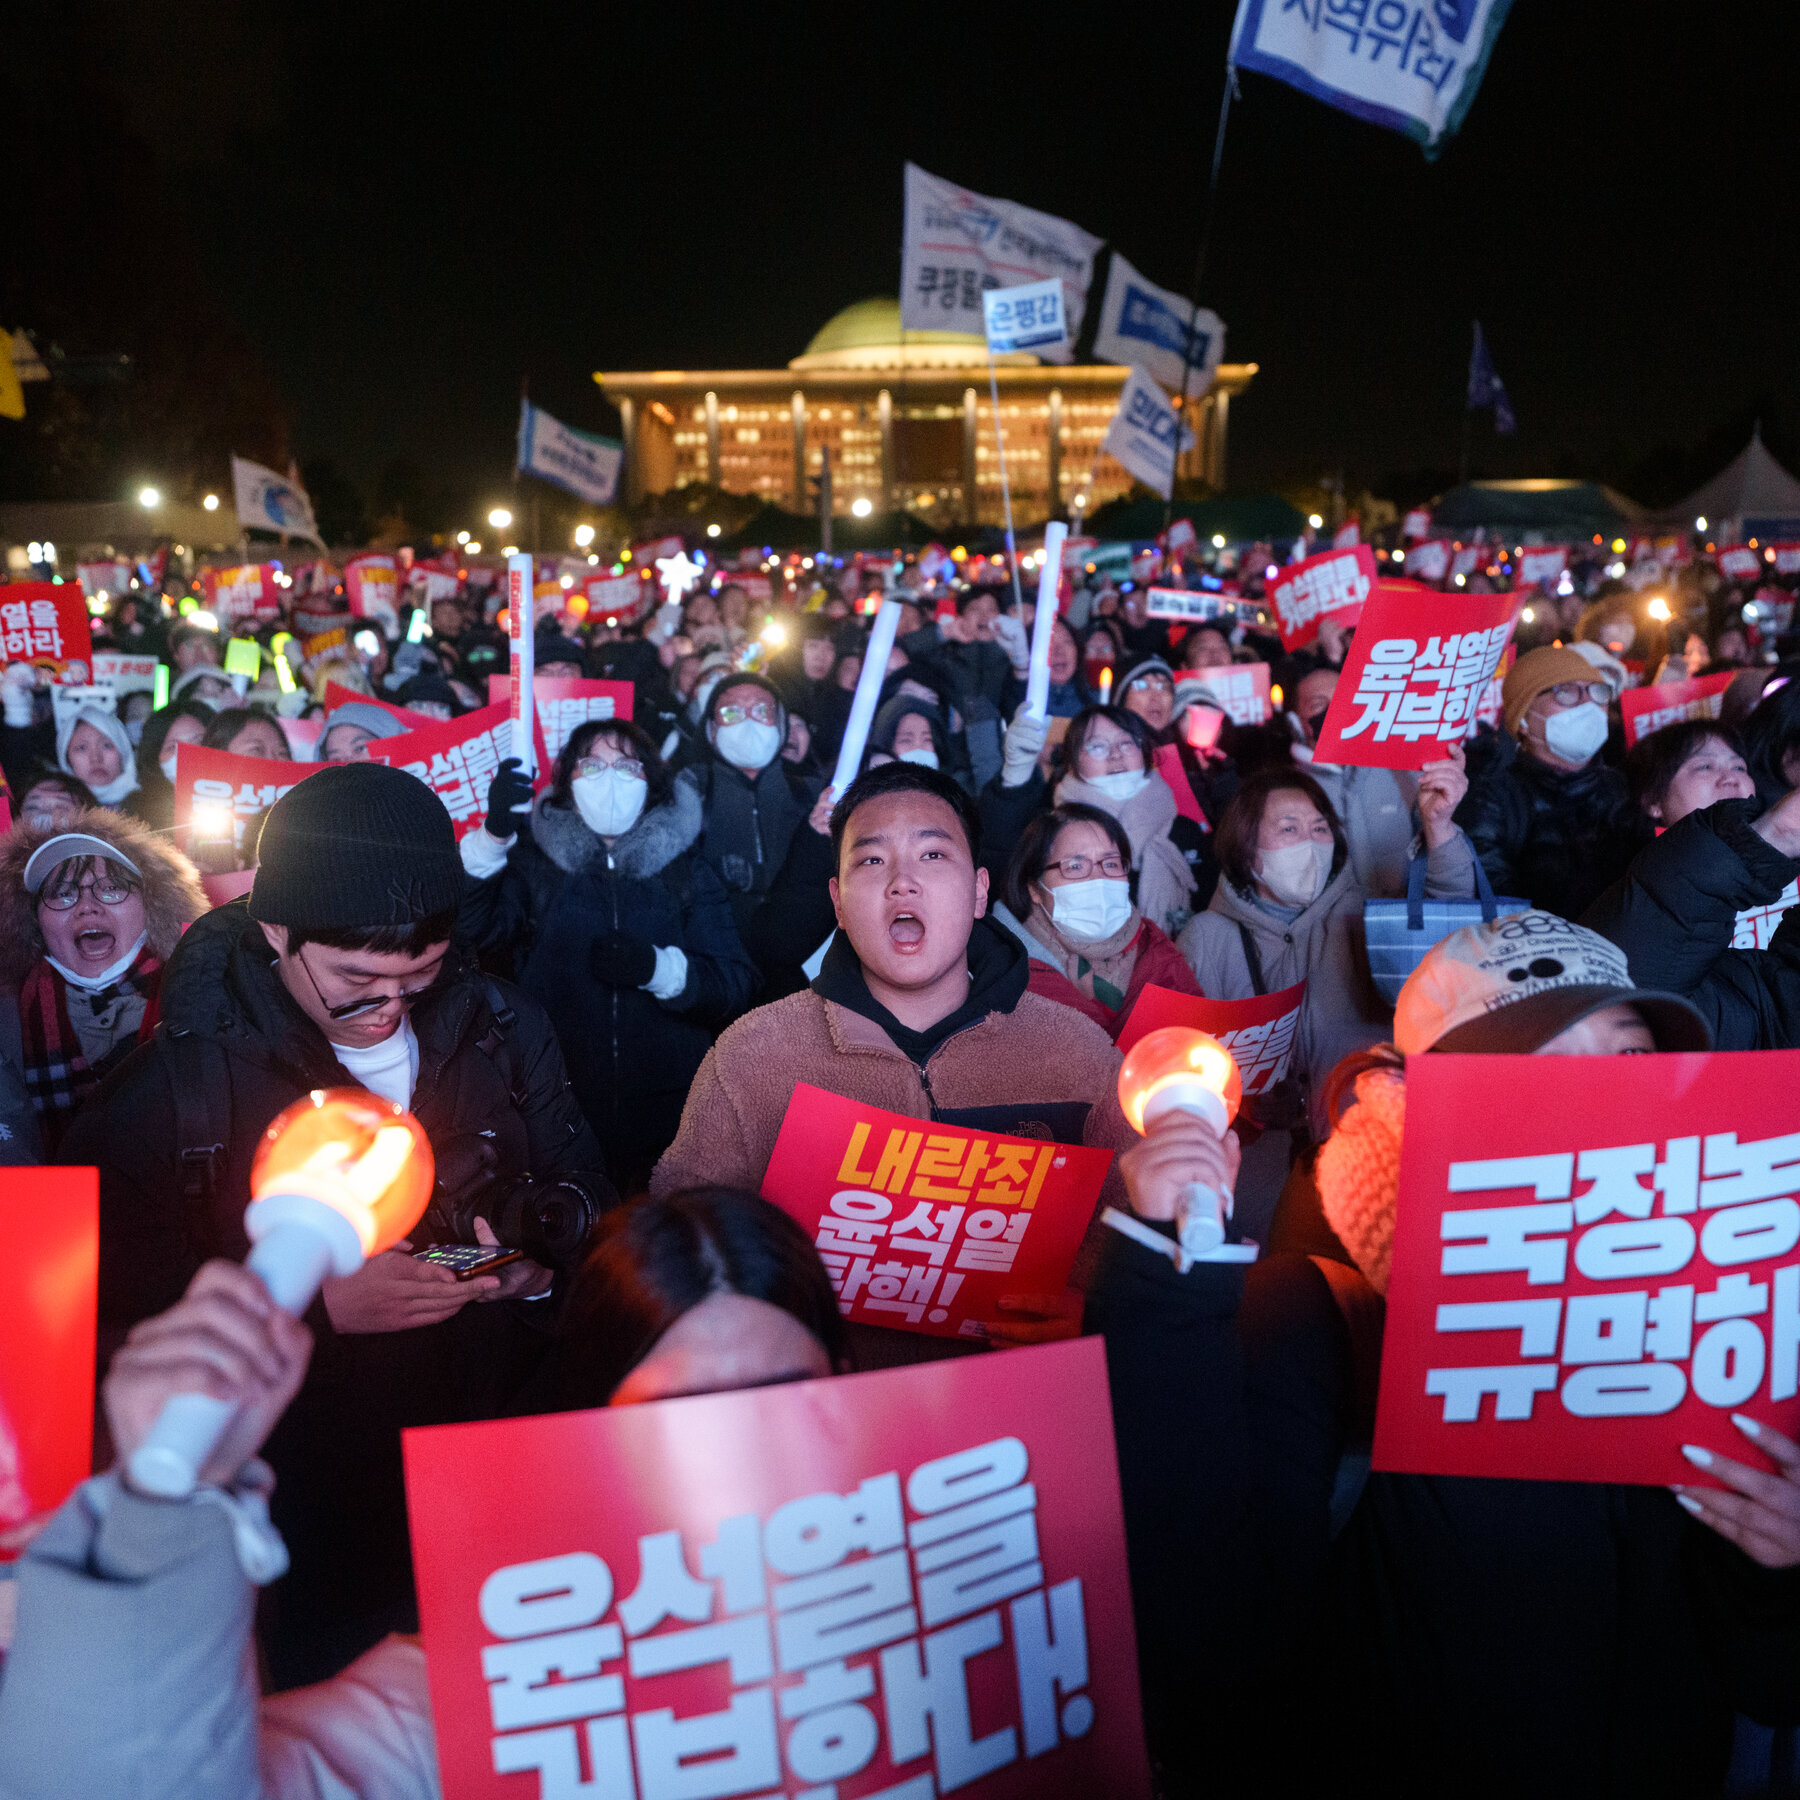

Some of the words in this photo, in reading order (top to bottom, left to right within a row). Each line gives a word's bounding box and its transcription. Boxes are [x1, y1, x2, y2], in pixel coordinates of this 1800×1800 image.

[990, 293, 1058, 332] 은평갑
[0, 628, 64, 660] 하라
[1357, 621, 1510, 693] 윤석열을
[1340, 679, 1488, 743] 거부한
[1018, 1120, 1037, 1130] THE
[835, 1121, 1056, 1209] 내란죄
[815, 1190, 1032, 1273] 윤석열
[479, 1435, 1044, 1730] 윤석열을
